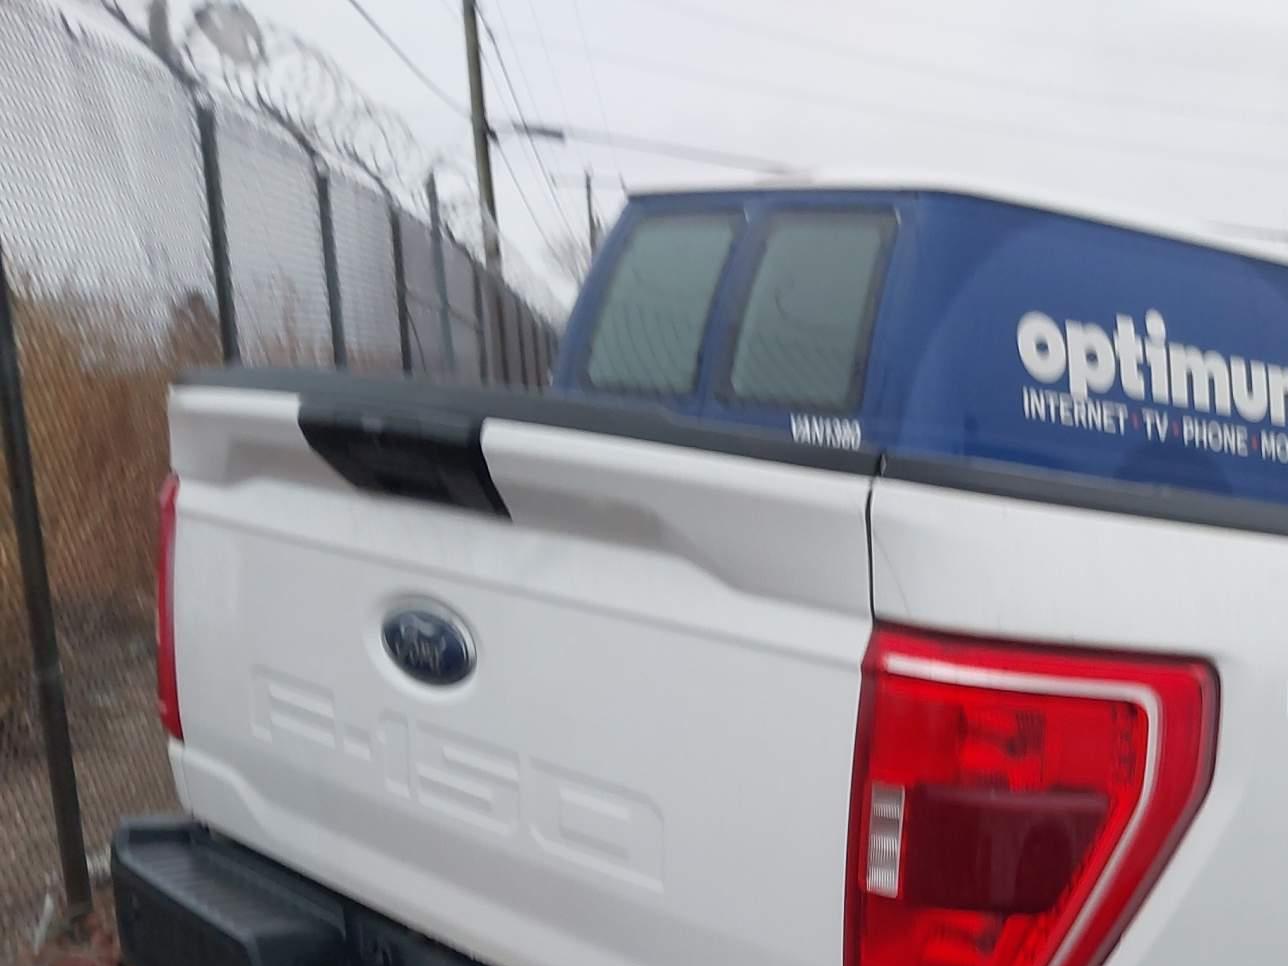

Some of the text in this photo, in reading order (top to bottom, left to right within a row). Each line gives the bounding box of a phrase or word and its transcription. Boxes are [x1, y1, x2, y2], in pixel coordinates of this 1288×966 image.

[1021, 385, 1128, 436] INTERNET
[1142, 408, 1169, 443] TV
[1182, 416, 1248, 458] PHONE
[250, 663, 663, 894] F-150
